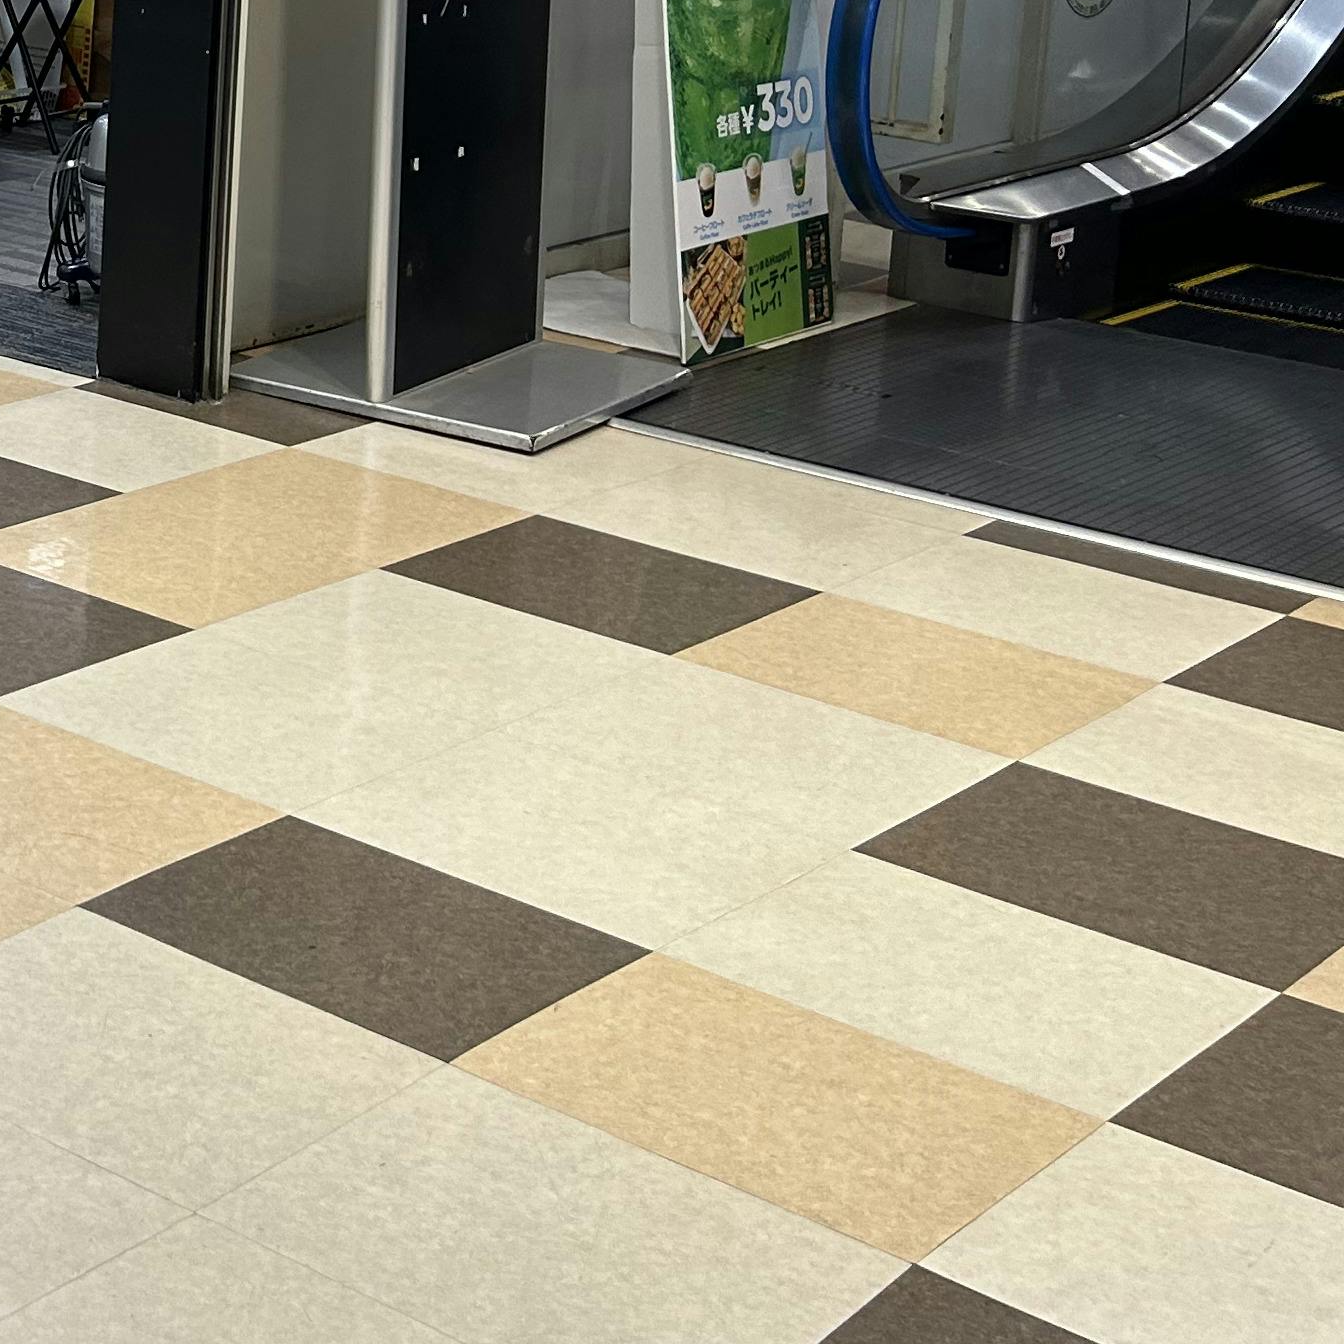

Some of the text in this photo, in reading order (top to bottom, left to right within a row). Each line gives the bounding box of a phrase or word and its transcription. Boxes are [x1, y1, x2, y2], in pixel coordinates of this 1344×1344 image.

[749, 264, 799, 299] パーティー
[752, 291, 782, 321] トレイ!
